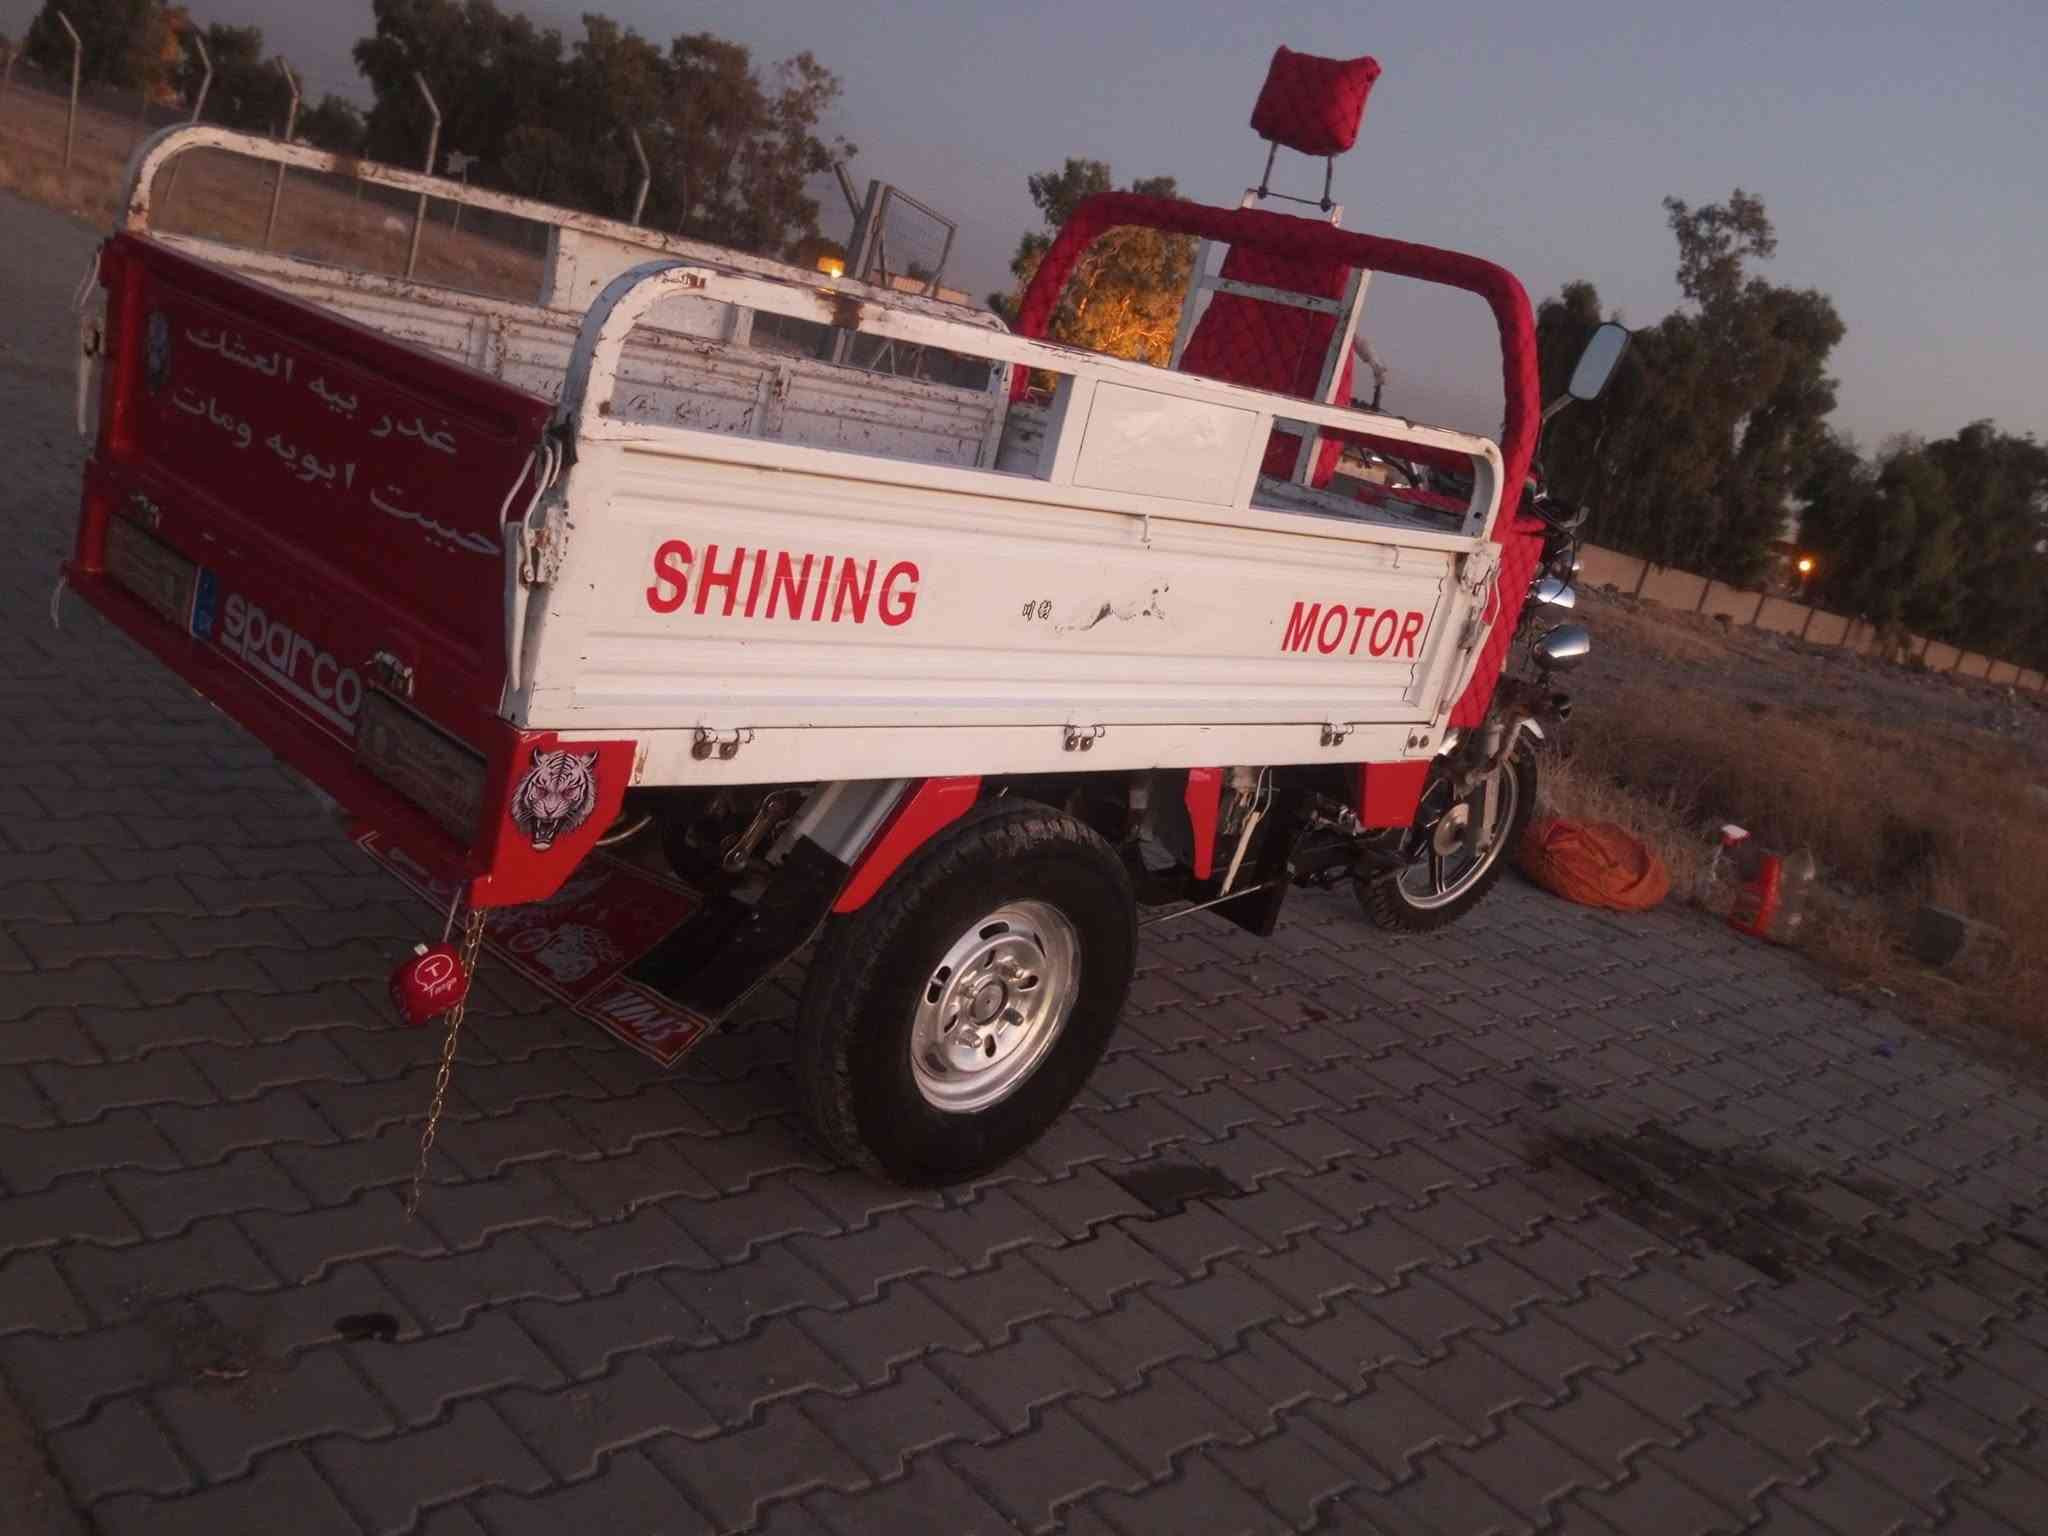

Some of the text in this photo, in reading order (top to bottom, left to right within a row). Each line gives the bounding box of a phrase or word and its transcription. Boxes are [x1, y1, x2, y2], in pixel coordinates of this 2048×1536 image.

[171, 386, 251, 449] ومات
[308, 375, 358, 420] بيه
[367, 415, 458, 454] غدر
[369, 486, 500, 555] حبيت
[645, 539, 920, 627] SHINING
[222, 592, 362, 717] sparco
[1281, 601, 1425, 658] MOTOR
